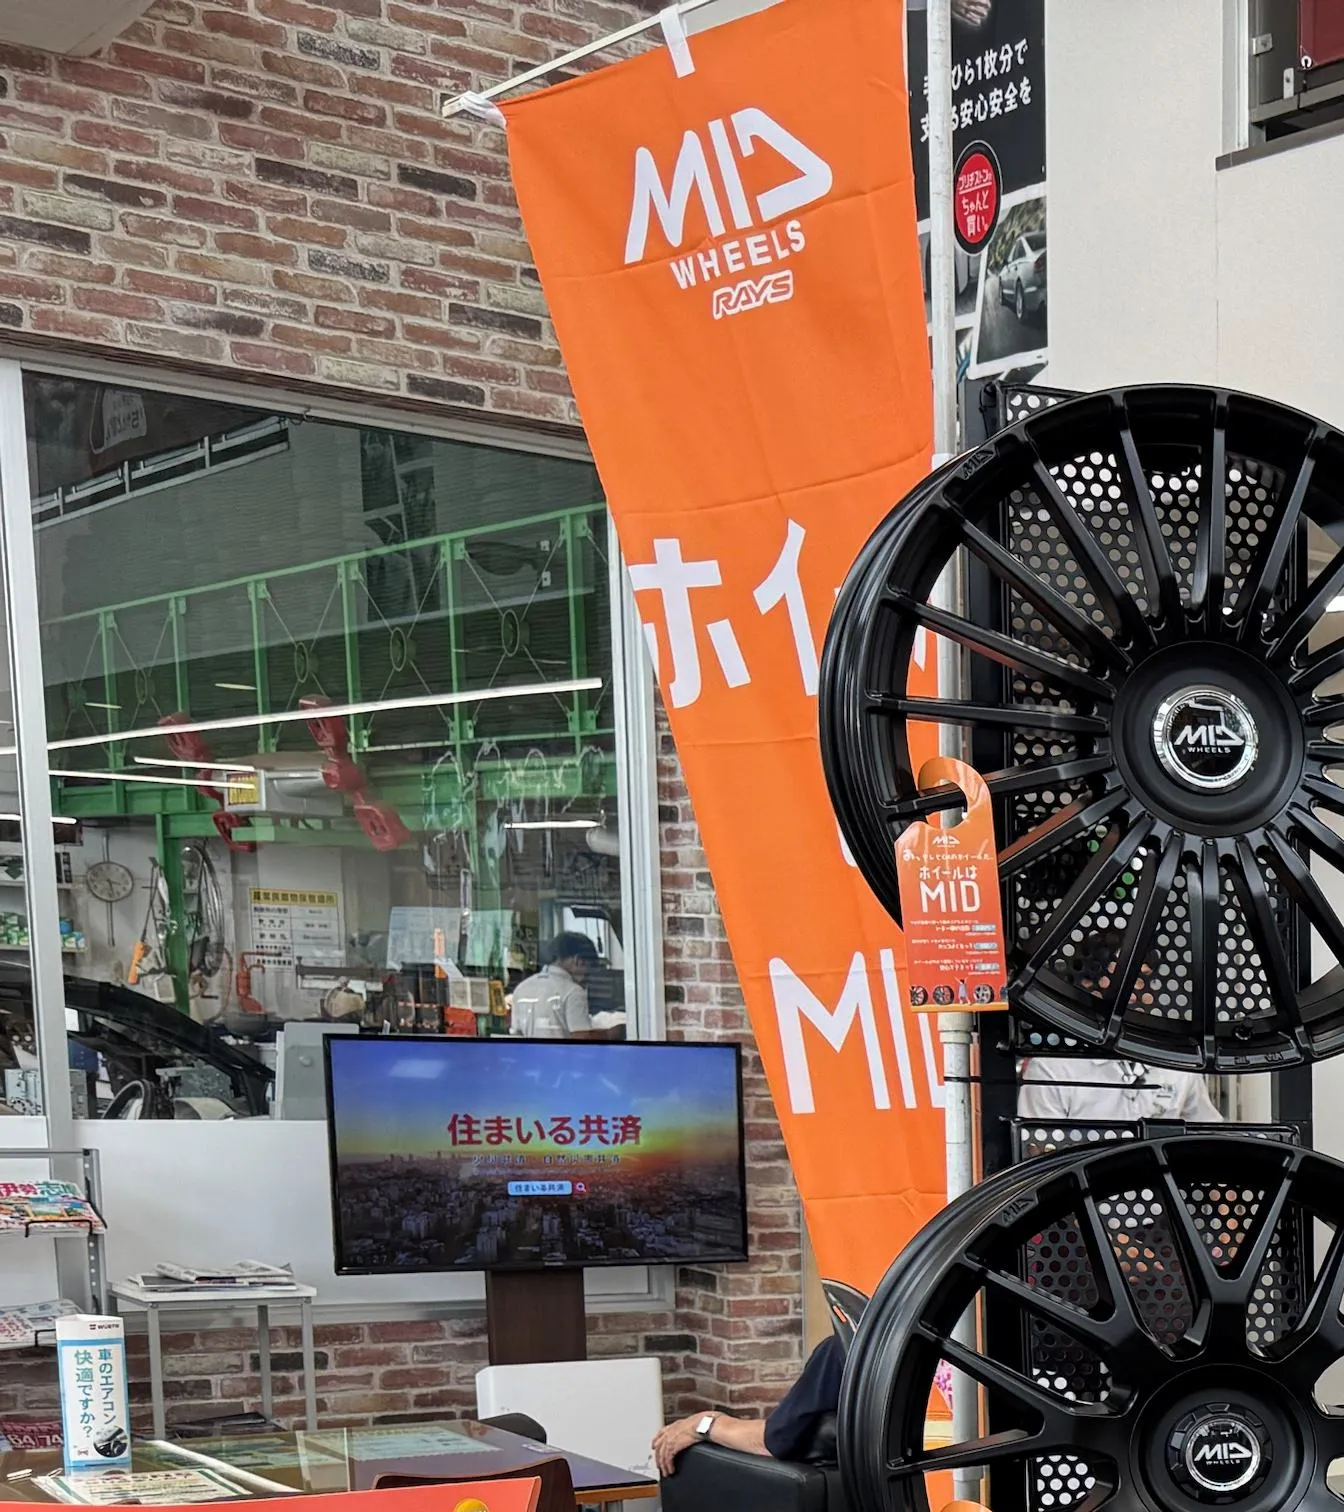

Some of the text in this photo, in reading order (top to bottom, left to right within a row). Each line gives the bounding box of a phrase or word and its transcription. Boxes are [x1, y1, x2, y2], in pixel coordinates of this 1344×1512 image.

[625, 108, 832, 264] MID
[961, 191, 989, 215] ちゃんと
[670, 219, 806, 290] WHEELS
[712, 269, 793, 320] RAYS
[1174, 725, 1244, 745] MID
[919, 865, 977, 881] ホイールは
[920, 880, 981, 913] MID
[447, 1114, 642, 1146] 住まいる共済
[74, 1350, 94, 1438] 快適ですか?
[98, 1348, 117, 1425] 車のエアコン
[1194, 1442, 1252, 1461] MID
